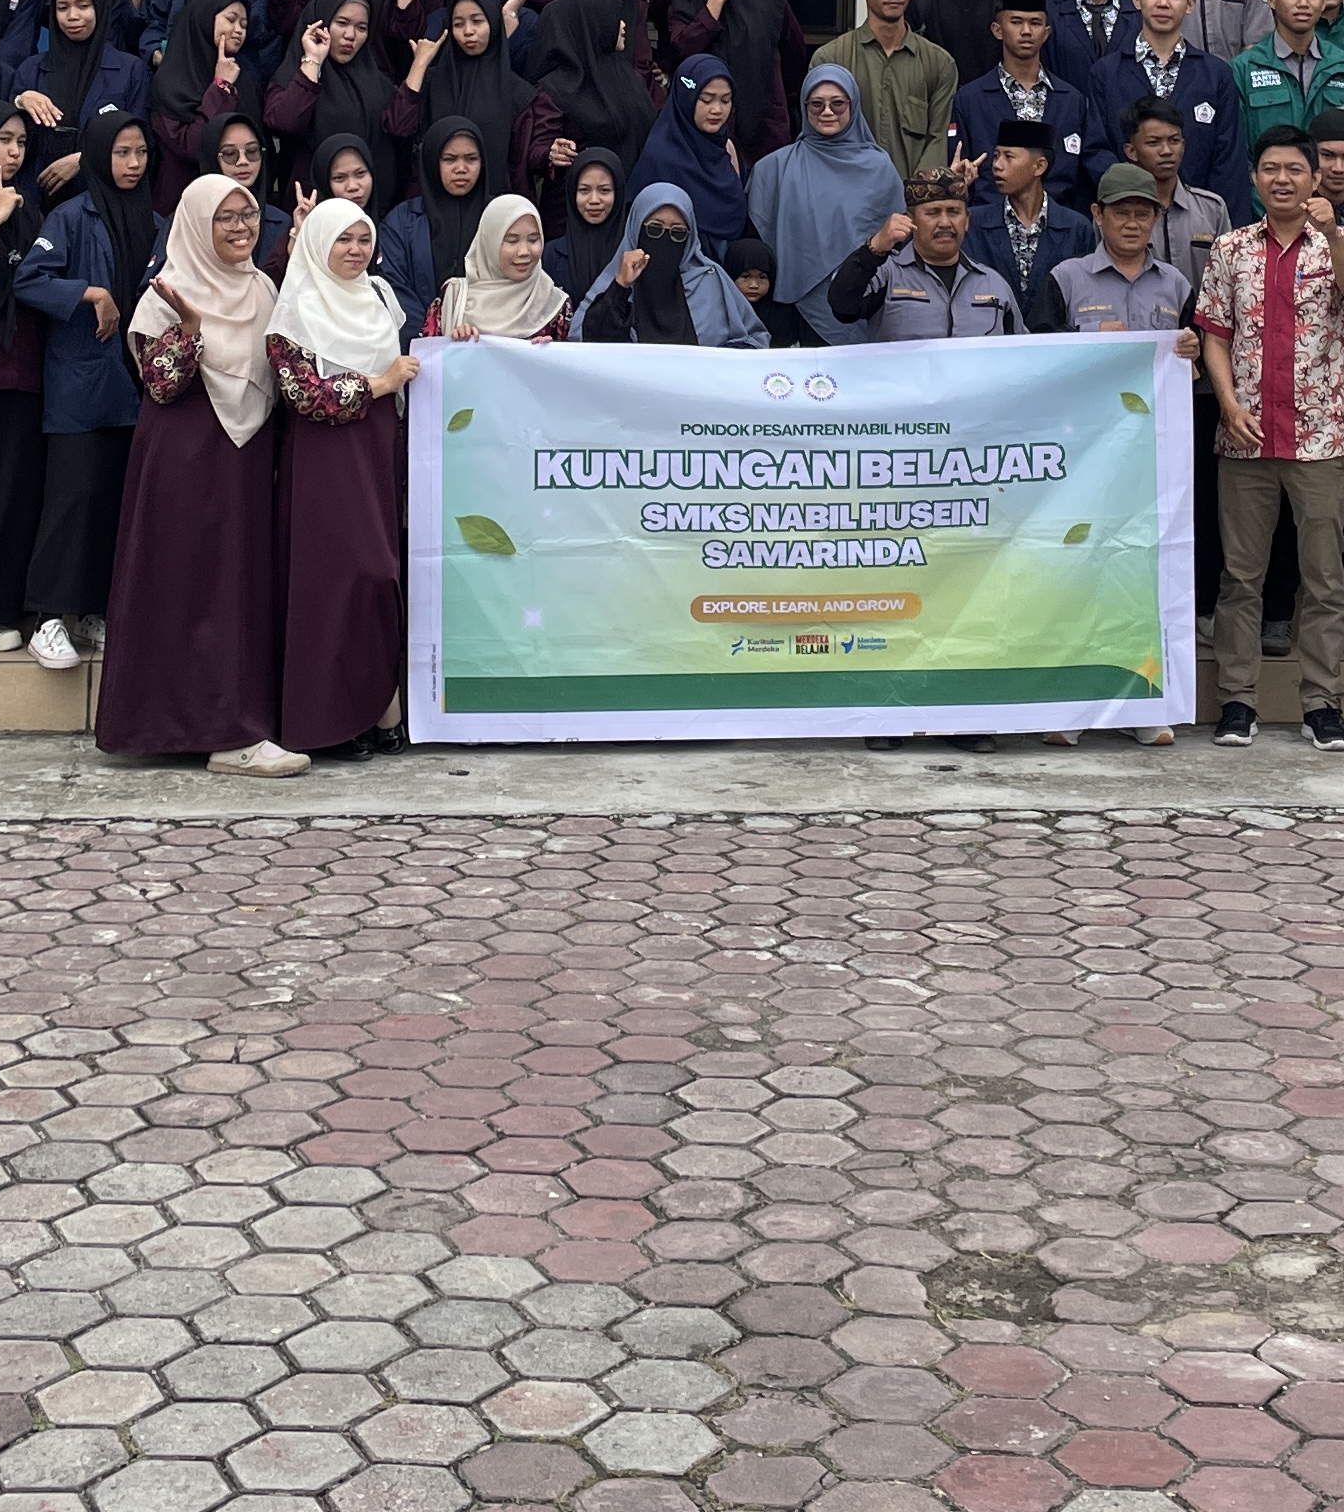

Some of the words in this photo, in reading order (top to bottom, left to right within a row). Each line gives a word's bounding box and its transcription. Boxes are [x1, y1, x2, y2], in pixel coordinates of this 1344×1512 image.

[680, 423, 750, 436] PONDOK
[752, 423, 845, 436] PESANTREN
[847, 423, 892, 435] NABIL
[894, 422, 951, 435] HUSEIN
[535, 450, 851, 489] KUNJUNGAN
[856, 442, 1067, 488] BELAJAR
[641, 503, 752, 532] SMKS
[751, 501, 860, 531] NABIL
[859, 498, 989, 531] HUSEIN
[702, 538, 928, 569] SAMARINDA
[702, 601, 771, 615] EXPLORE,
[772, 601, 821, 614] LEARN,
[823, 600, 854, 613] AND
[856, 599, 906, 612] GROW
[795, 634, 829, 644] MERDEKA
[795, 644, 829, 655] BELAJAR
